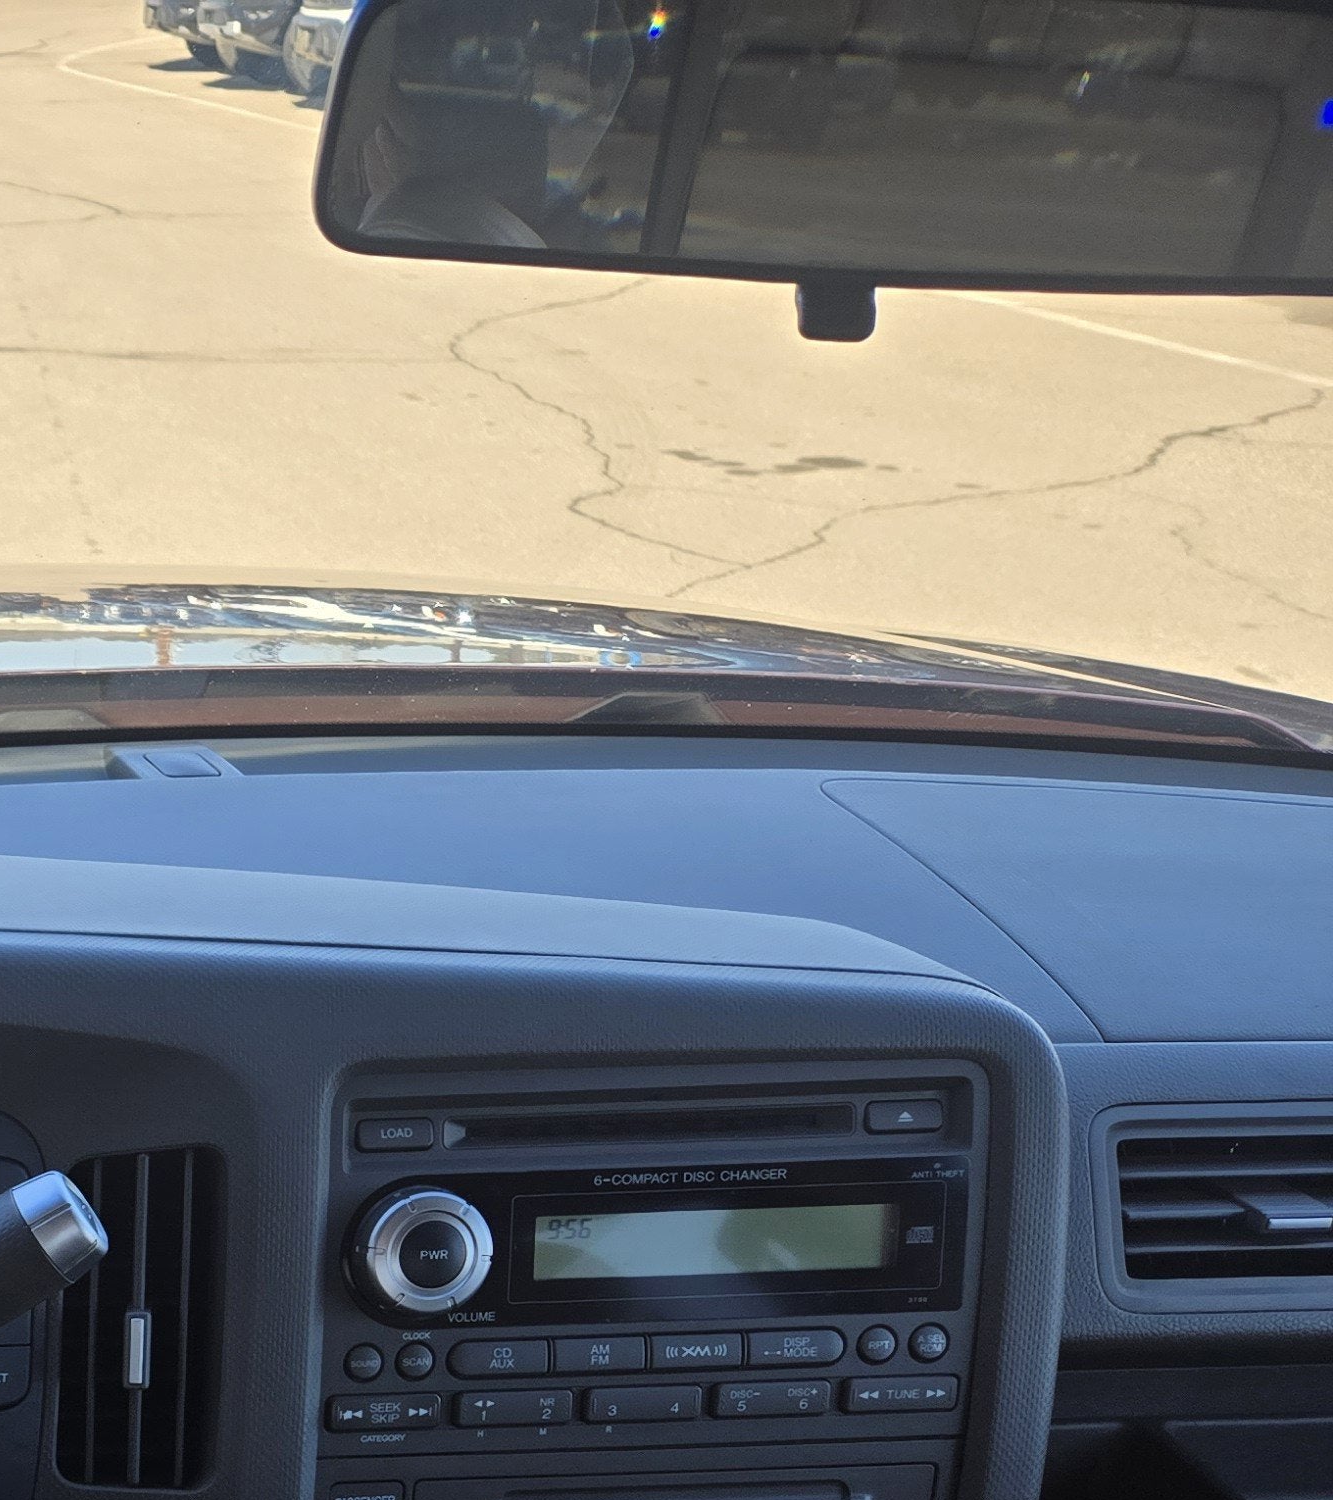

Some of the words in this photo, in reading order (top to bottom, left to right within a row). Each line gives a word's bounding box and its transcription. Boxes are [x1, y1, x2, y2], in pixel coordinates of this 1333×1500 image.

[380, 1127, 413, 1139] LOAD
[593, 1172, 678, 1186] 6-COMPACT
[683, 1171, 715, 1183] DISC
[720, 1168, 787, 1181] CHANGER
[935, 1169, 965, 1179] THEFT
[419, 1250, 449, 1261] PWR
[448, 1311, 496, 1323] VOLUME
[402, 1332, 431, 1341] CLOCK
[784, 1337, 810, 1347] DISP
[590, 1344, 610, 1355] AM
[868, 1339, 891, 1351] RPT
[493, 1348, 513, 1358] CD
[783, 1347, 818, 1358] MODE
[350, 1360, 378, 1369] SOUND
[401, 1358, 430, 1367] SCAN
[489, 1358, 515, 1369] AUX
[590, 1355, 610, 1366] FM
[886, 1389, 920, 1399] TUNE
[369, 1402, 401, 1413] SEEK
[539, 1397, 555, 1407] NR
[670, 1402, 679, 1413] 4
[737, 1401, 747, 1412] 5
[799, 1398, 808, 1410] 6
[541, 1409, 552, 1419] 2
[608, 1405, 617, 1417] 3
[371, 1413, 400, 1424] SKIP
[360, 1433, 406, 1444] CATEGORY
